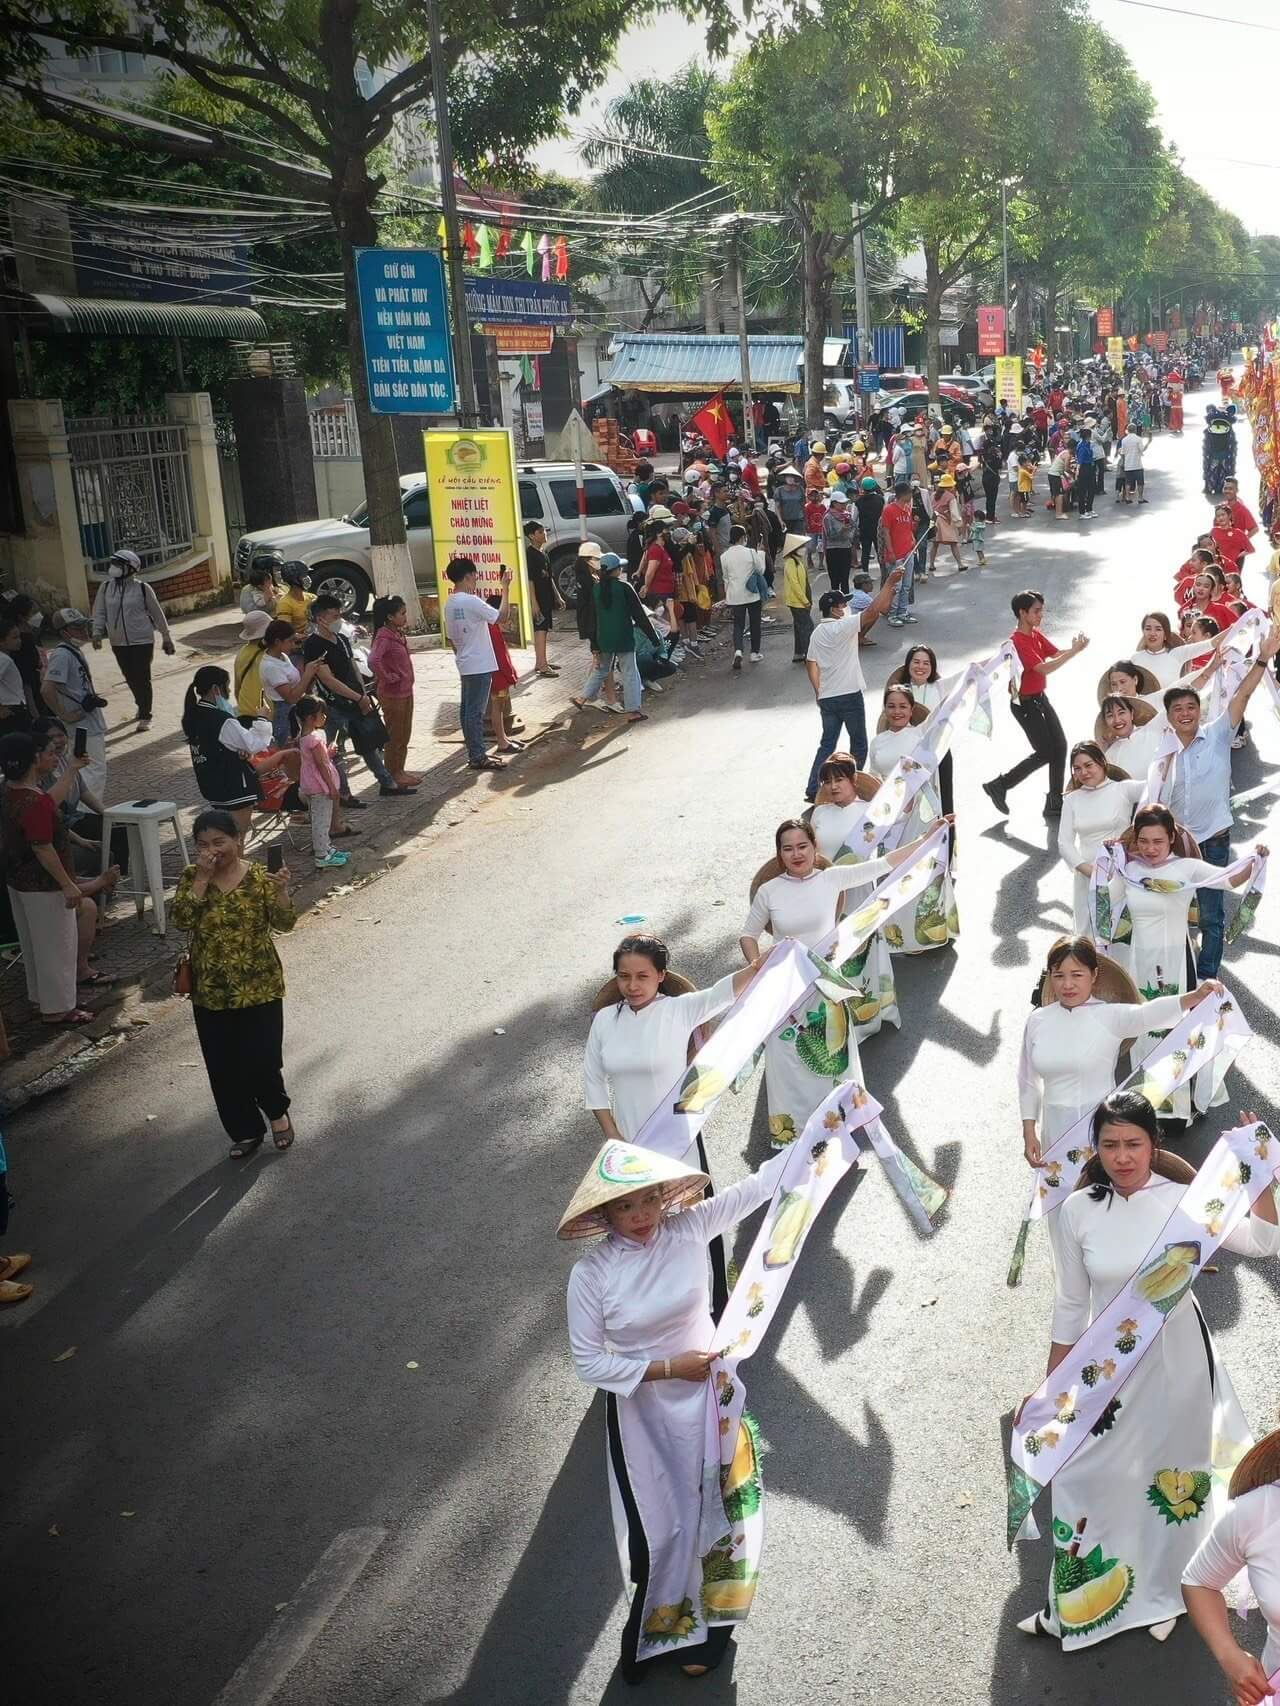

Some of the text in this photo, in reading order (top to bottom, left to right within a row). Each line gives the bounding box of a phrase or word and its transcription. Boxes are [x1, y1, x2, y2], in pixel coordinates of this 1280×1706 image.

[383, 262, 416, 279] GIỮ GÌN
[375, 285, 428, 303] VÀ PHÁT HUY
[464, 287, 486, 313] RƯỜNG
[377, 306, 431, 326] NỀN VĂN HÓA
[387, 333, 426, 352] VIỆT NAM
[374, 380, 391, 398] BẢN
[392, 379, 409, 398] SẮC
[451, 497, 489, 513] NHIỆT LIỆT
[450, 515, 494, 529] CHÀO MỪNG
[472, 532, 493, 546] ĐOÀN
[481, 552, 502, 564] QUAN
